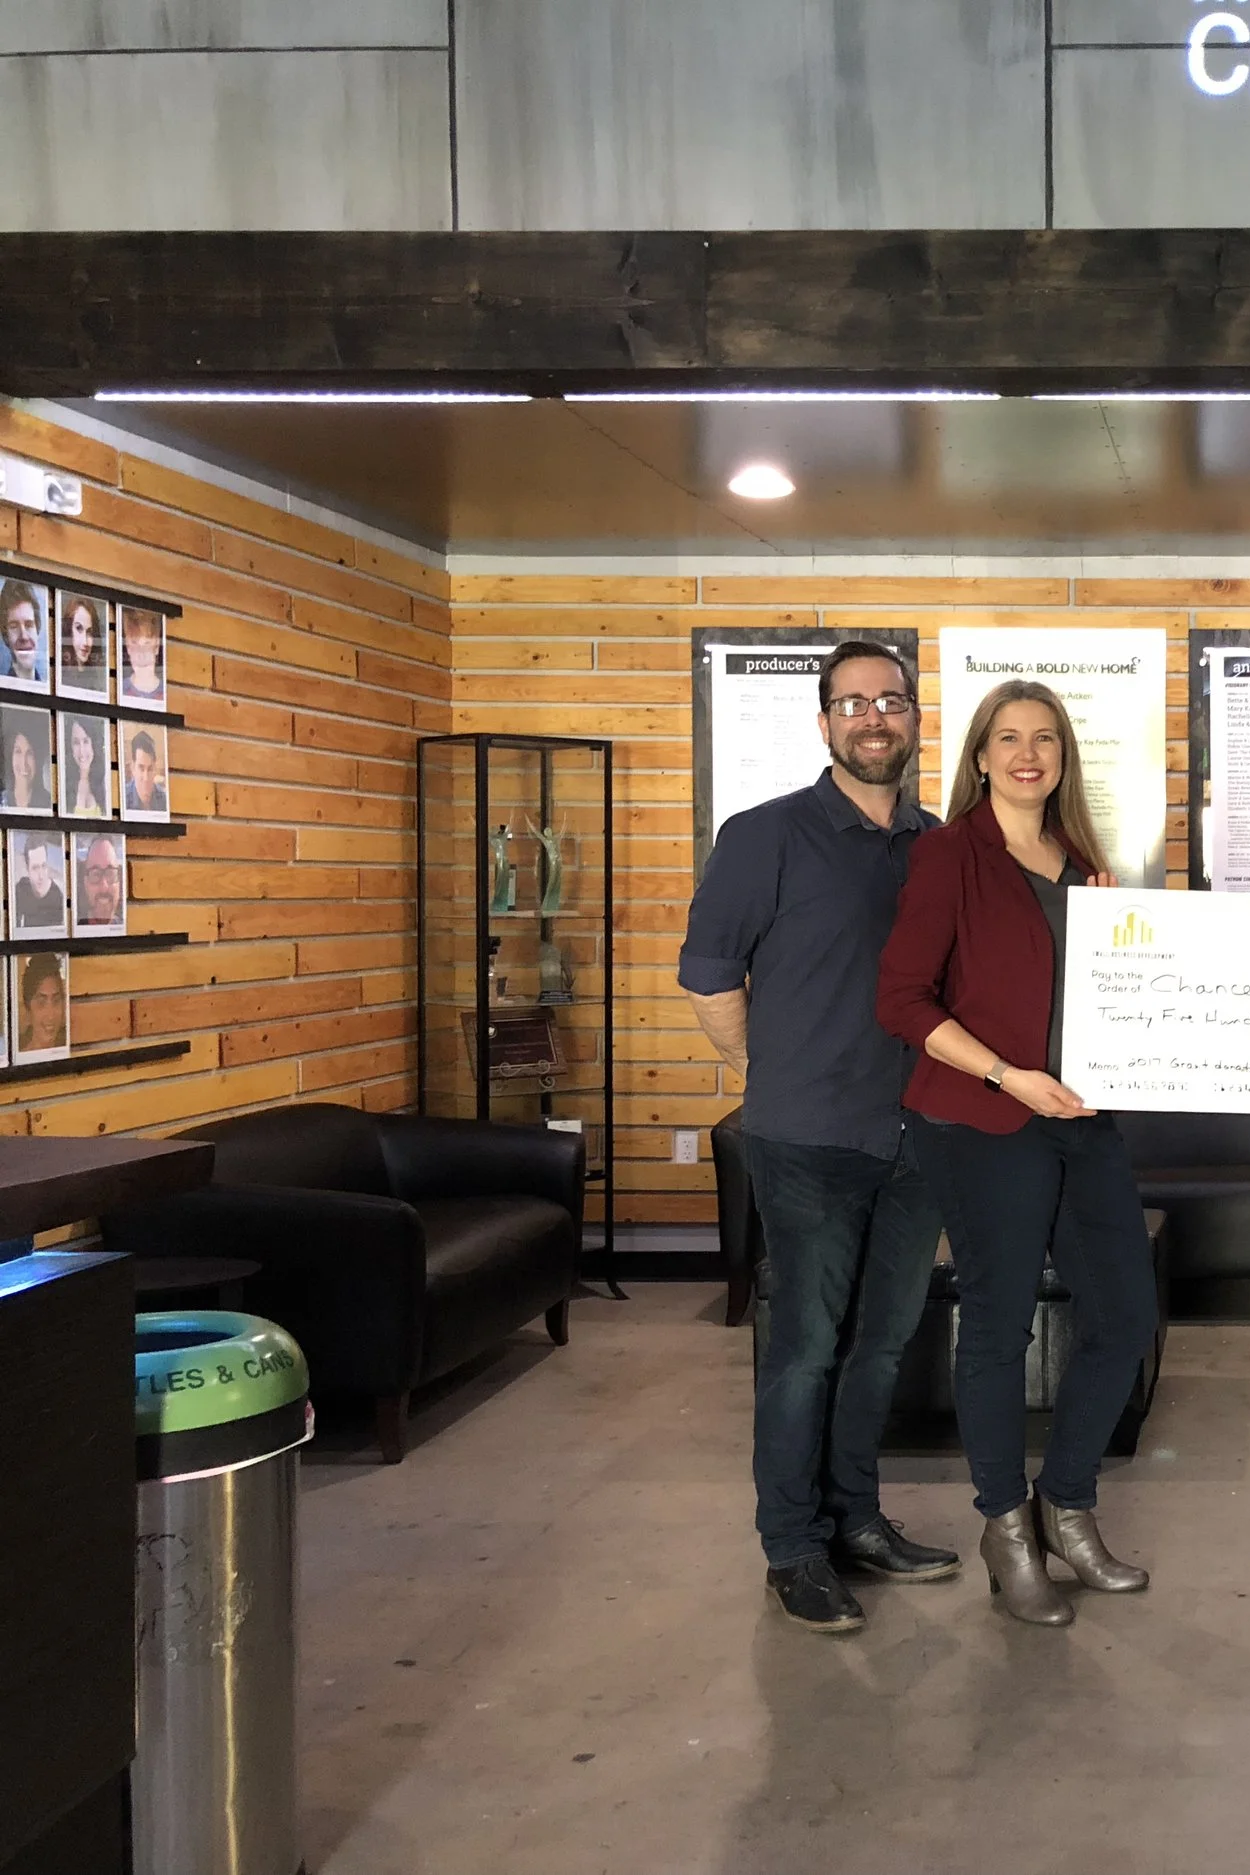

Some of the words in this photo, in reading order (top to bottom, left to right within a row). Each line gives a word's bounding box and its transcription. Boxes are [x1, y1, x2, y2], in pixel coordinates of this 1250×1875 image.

[745, 657, 820, 673] producer's
[966, 661, 1024, 673] BUILDING
[1026, 663, 1034, 673] A
[1036, 662, 1070, 674] BOLD
[1072, 663, 1098, 674] NEW
[1101, 663, 1137, 675] HOME
[1091, 969, 1111, 982] Pay
[1114, 971, 1125, 980] to
[1127, 971, 1143, 980] the
[1098, 983, 1127, 993] Order
[1130, 984, 1141, 993] of
[1097, 1006, 1152, 1028] Twenty
[1088, 1061, 1119, 1072] Memo
[1128, 1058, 1161, 1068] 2017
[216, 1364, 235, 1384] &
[243, 1349, 294, 1379] CANS
